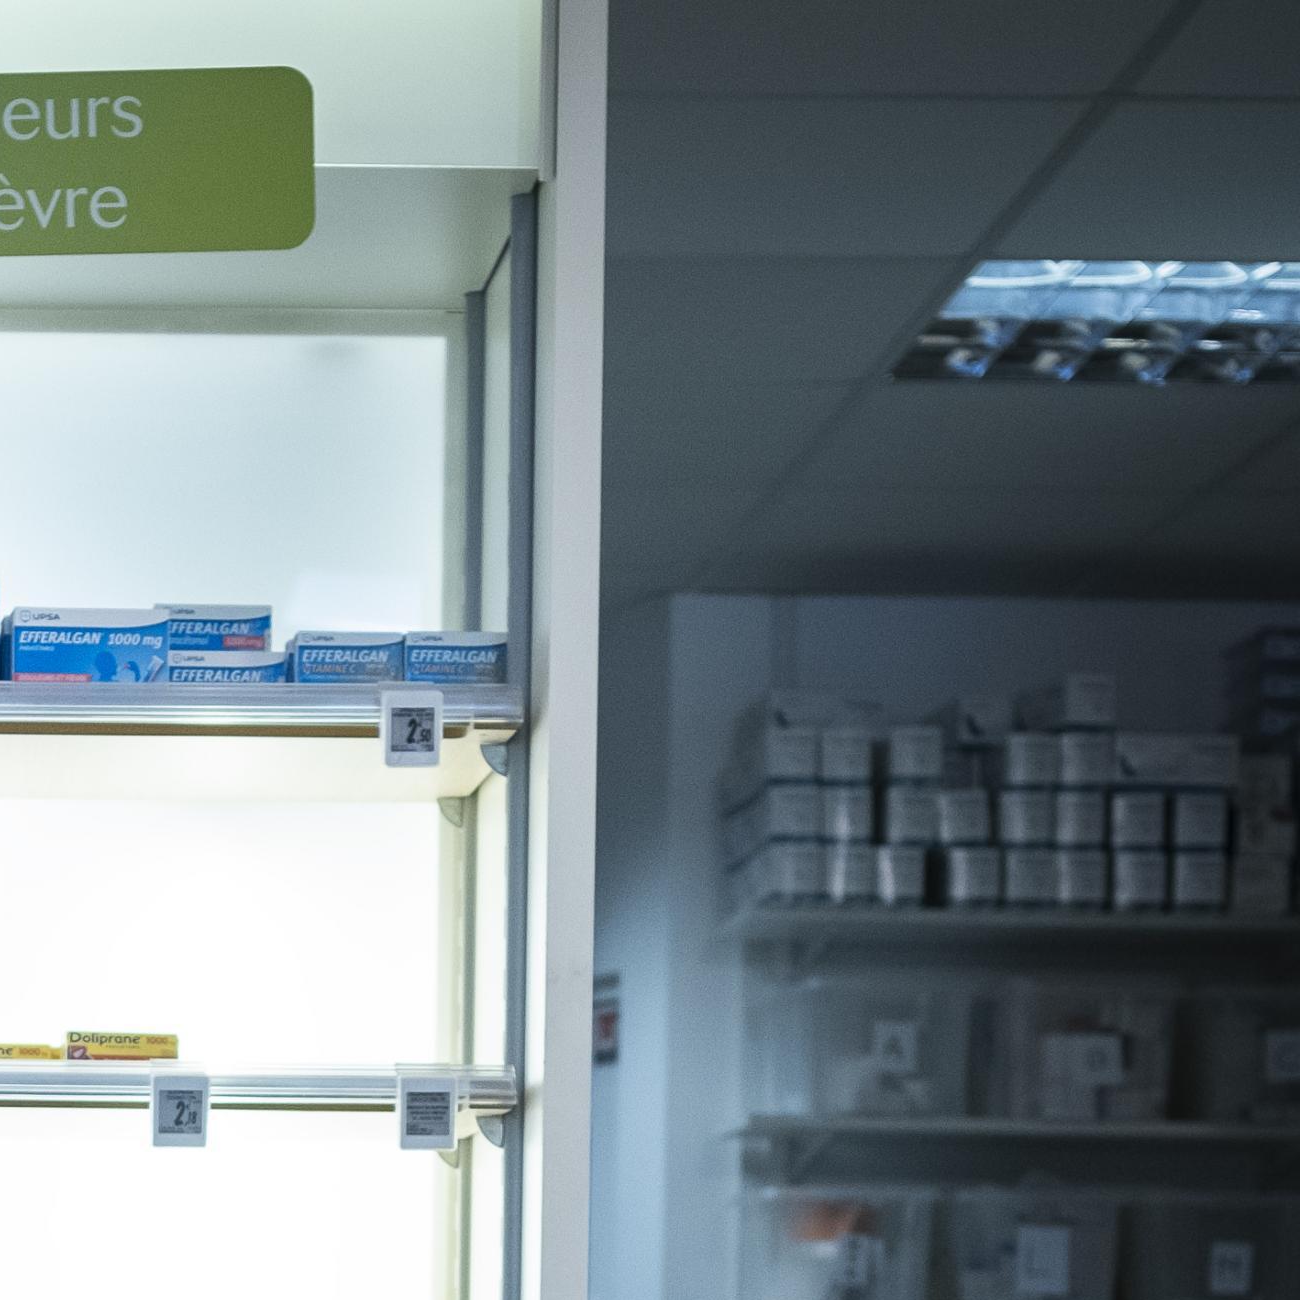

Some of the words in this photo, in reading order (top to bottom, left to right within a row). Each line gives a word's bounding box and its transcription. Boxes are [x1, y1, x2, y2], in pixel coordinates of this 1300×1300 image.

[32, 613, 60, 621] UPSA
[19, 631, 101, 644] EFFERALGAN
[108, 633, 140, 645] 1000
[143, 636, 163, 648] mg
[302, 650, 388, 662] EFFERALGAN
[411, 650, 497, 663] EFFERALGAN
[172, 670, 261, 682] EFFERALGAN
[69, 1032, 140, 1046] Doliprane
[146, 1037, 168, 1045] 1000
[19, 1048, 41, 1056] 1000
